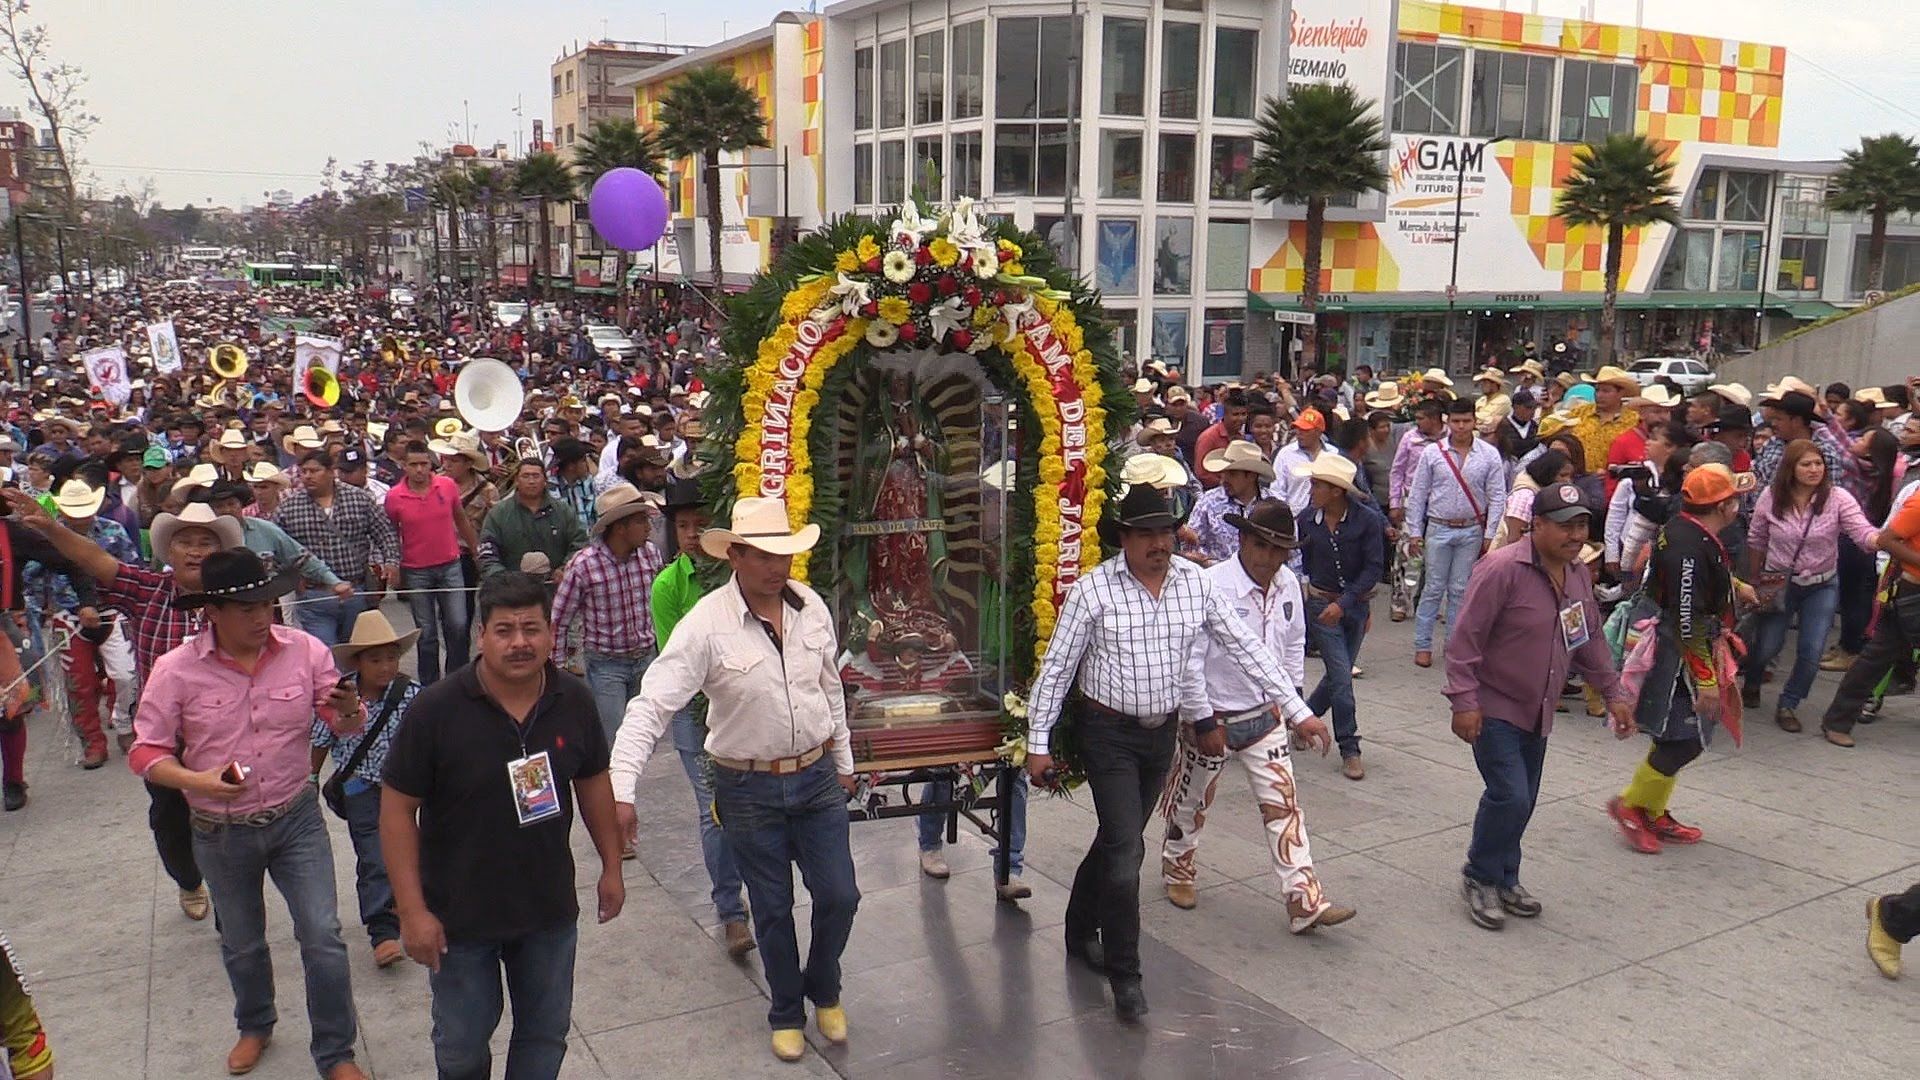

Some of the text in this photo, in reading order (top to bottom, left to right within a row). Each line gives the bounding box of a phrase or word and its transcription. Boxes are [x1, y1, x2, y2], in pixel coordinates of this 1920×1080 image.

[1290, 9, 1368, 54] Bienvenido
[1418, 140, 1484, 172] GAM
[1415, 184, 1454, 193] FUTURO
[1059, 398, 1086, 472] DEL
[1681, 557, 1696, 641] TOMBSTONE
